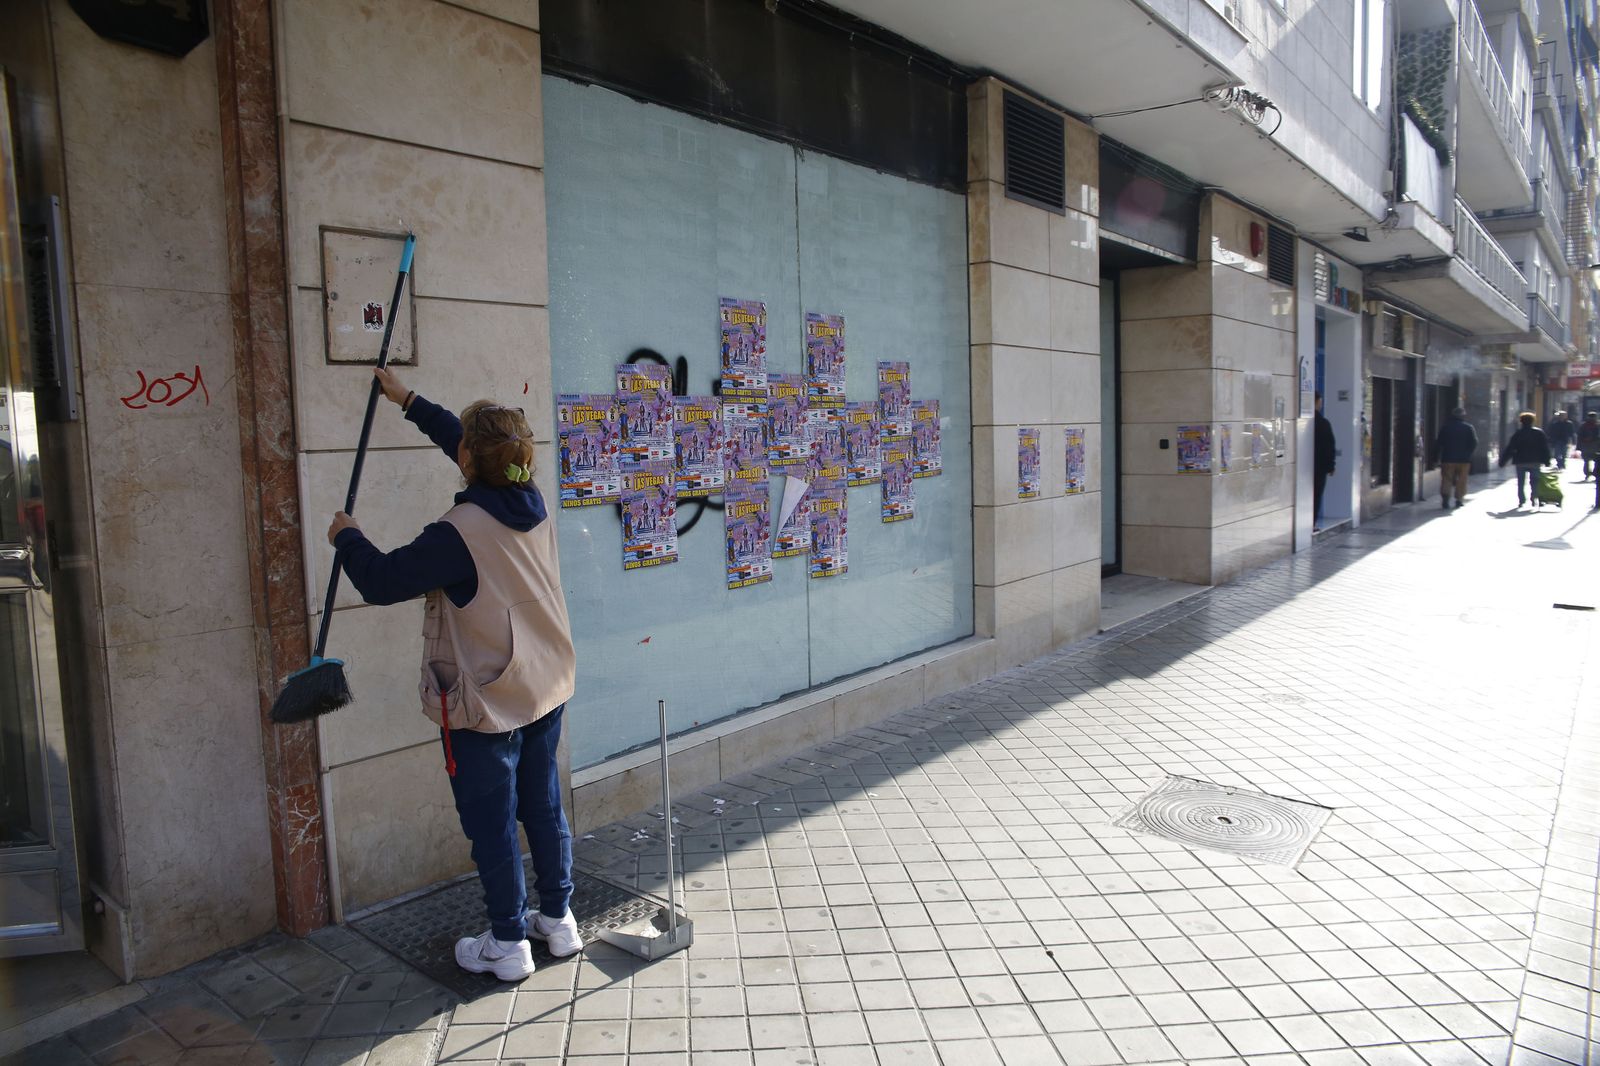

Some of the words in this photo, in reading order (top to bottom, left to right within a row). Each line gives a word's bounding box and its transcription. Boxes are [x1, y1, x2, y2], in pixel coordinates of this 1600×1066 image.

[732, 313, 741, 325] LAS
[742, 314, 756, 323] VEGAS
[631, 380, 642, 392] LAS
[643, 380, 660, 390] VEGAS
[573, 411, 584, 426] LAS
[585, 409, 606, 421] VEGAS
[685, 411, 695, 424] LAS
[695, 410, 713, 420] VEGAS
[634, 478, 645, 491] LAS
[646, 476, 664, 487] VEGAS
[736, 506, 745, 519] LAS
[746, 504, 761, 513] VEGAS
